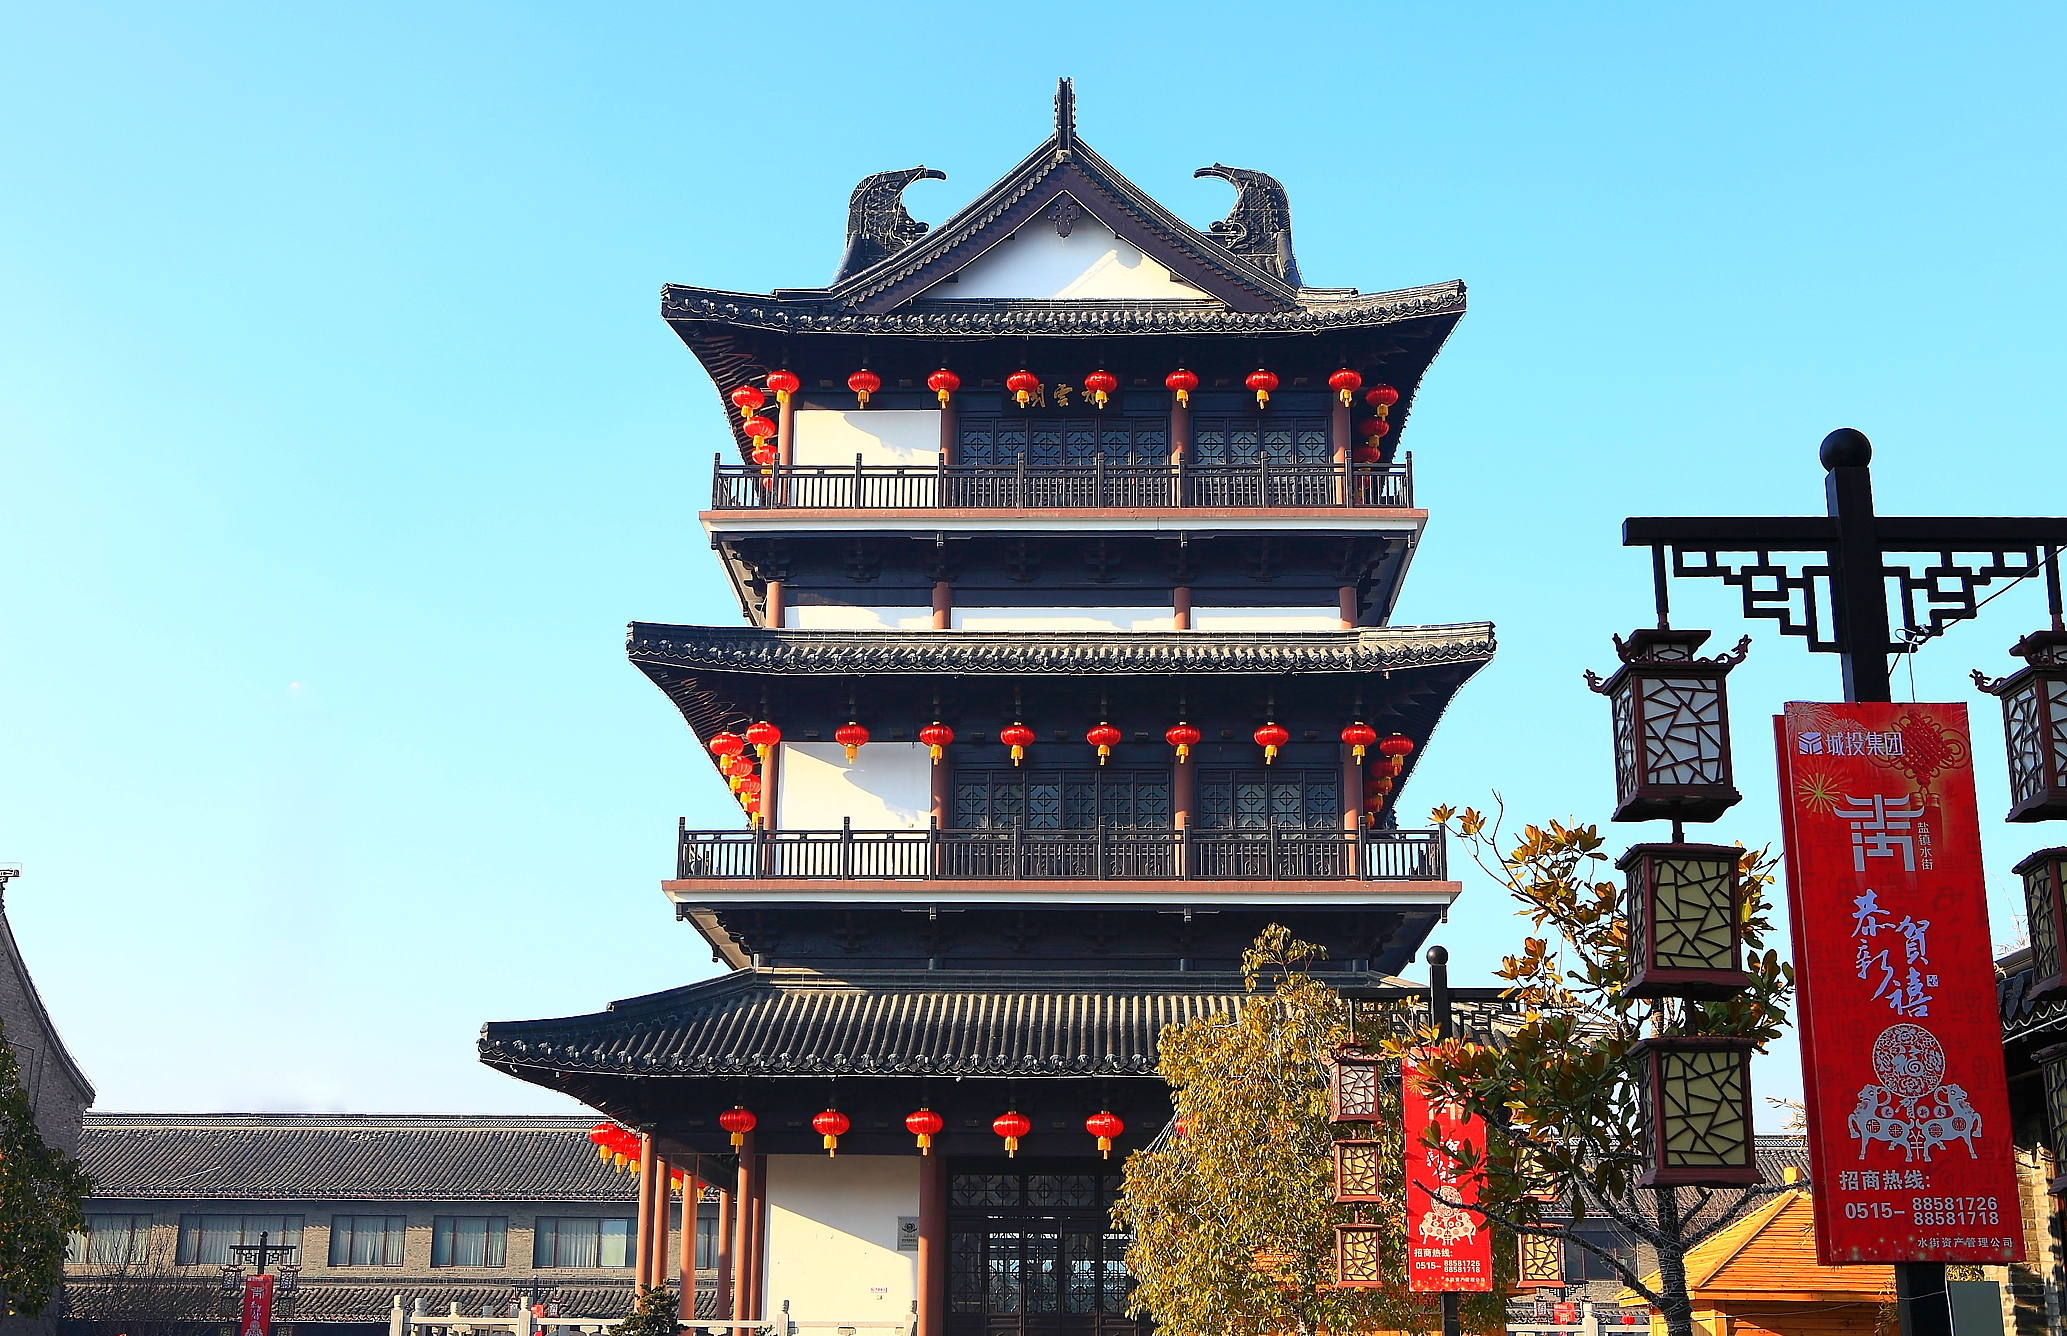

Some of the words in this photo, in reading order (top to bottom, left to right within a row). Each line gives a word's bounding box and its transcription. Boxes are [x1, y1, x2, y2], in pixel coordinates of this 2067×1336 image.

[1826, 731, 1904, 756] 城投集团
[1917, 822, 1933, 870] 盐镇水街
[1839, 1170, 1931, 1191] 招商热线:
[1912, 1197, 1998, 1211] 88581726
[1914, 1212, 1999, 1226] 88581718
[1917, 1237, 2013, 1248] 水街资产管理公司
[1444, 1259, 1481, 1267] 88581726
